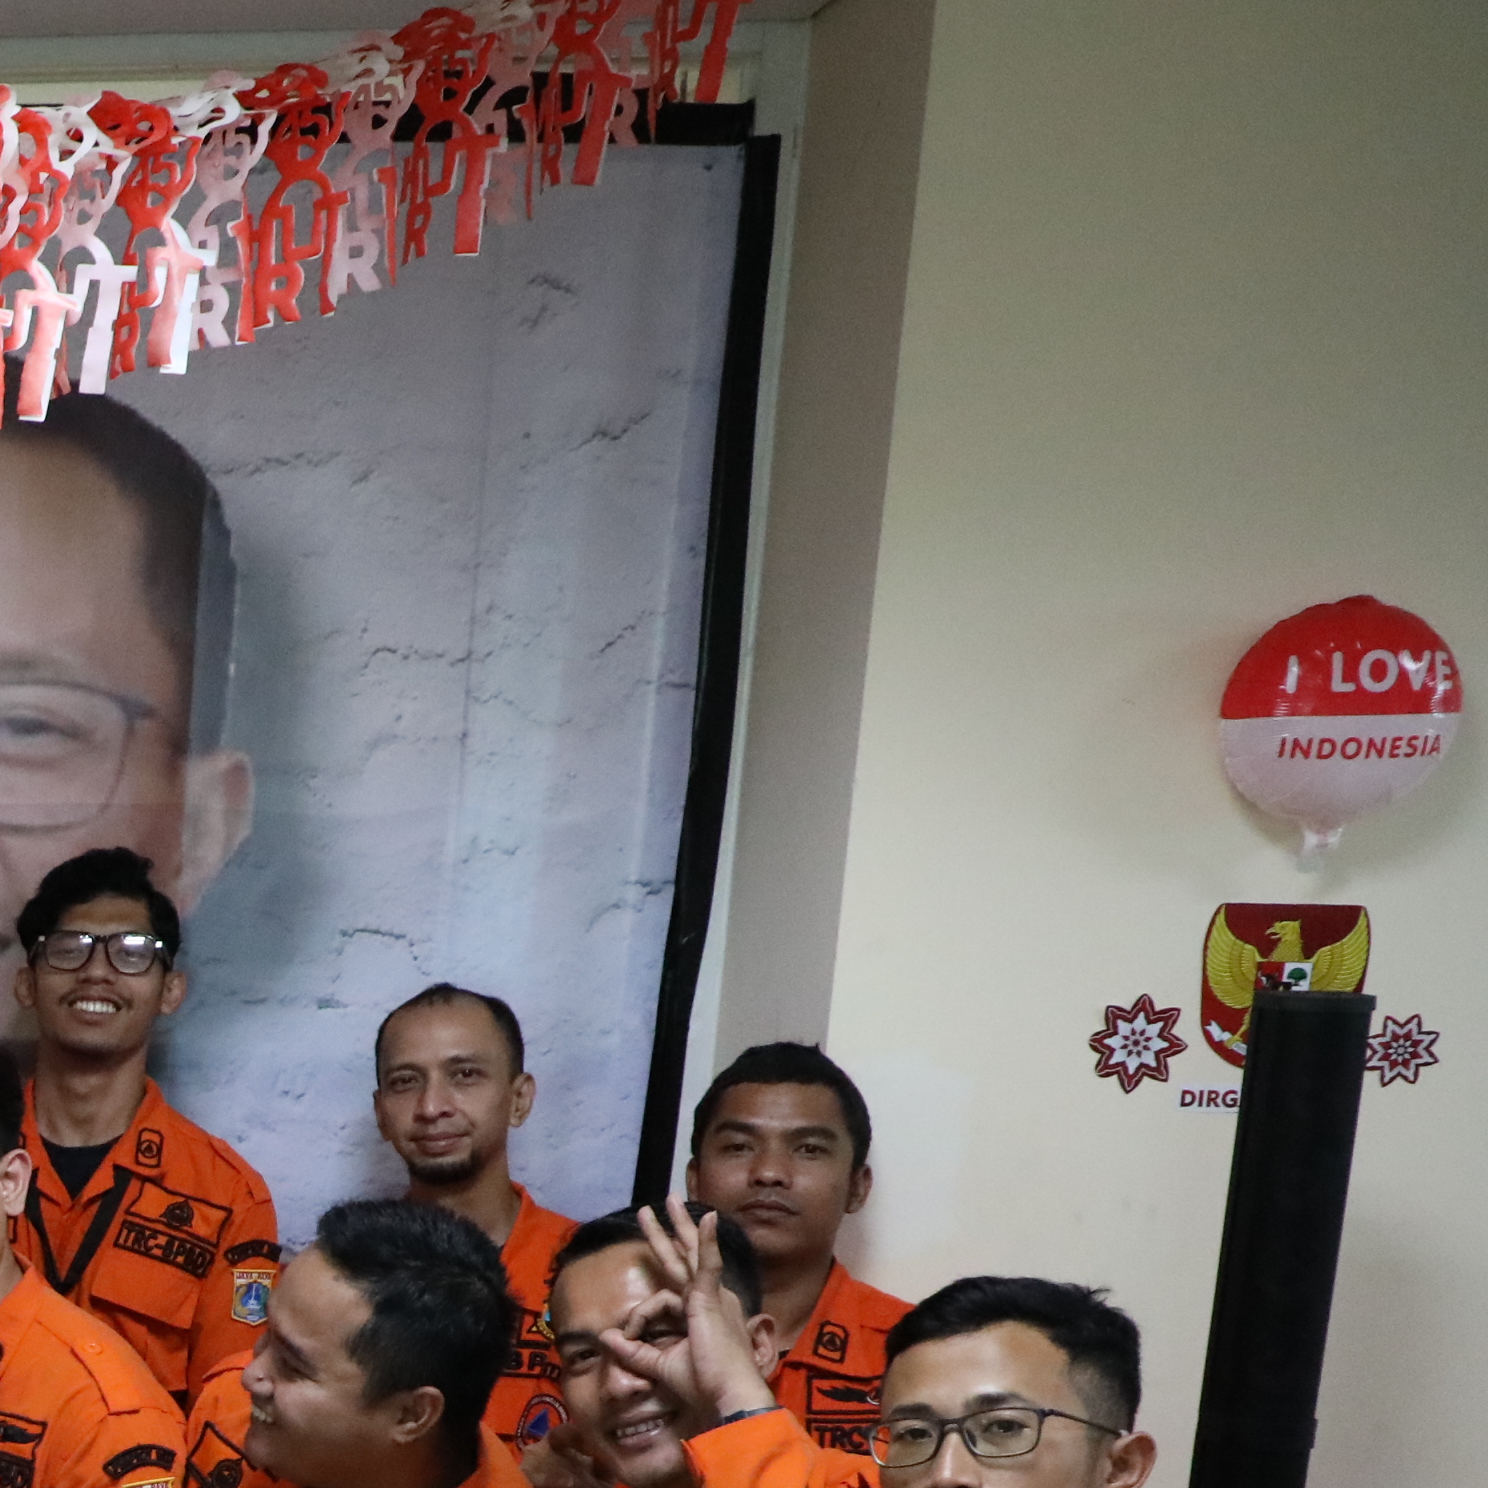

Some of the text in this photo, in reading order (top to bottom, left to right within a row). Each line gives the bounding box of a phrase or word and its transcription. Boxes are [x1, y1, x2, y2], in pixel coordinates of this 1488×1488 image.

[1284, 648, 1454, 694] I LOVE
[1276, 733, 1442, 760] INDONESIA
[1180, 1089, 1241, 1109] DIRG
